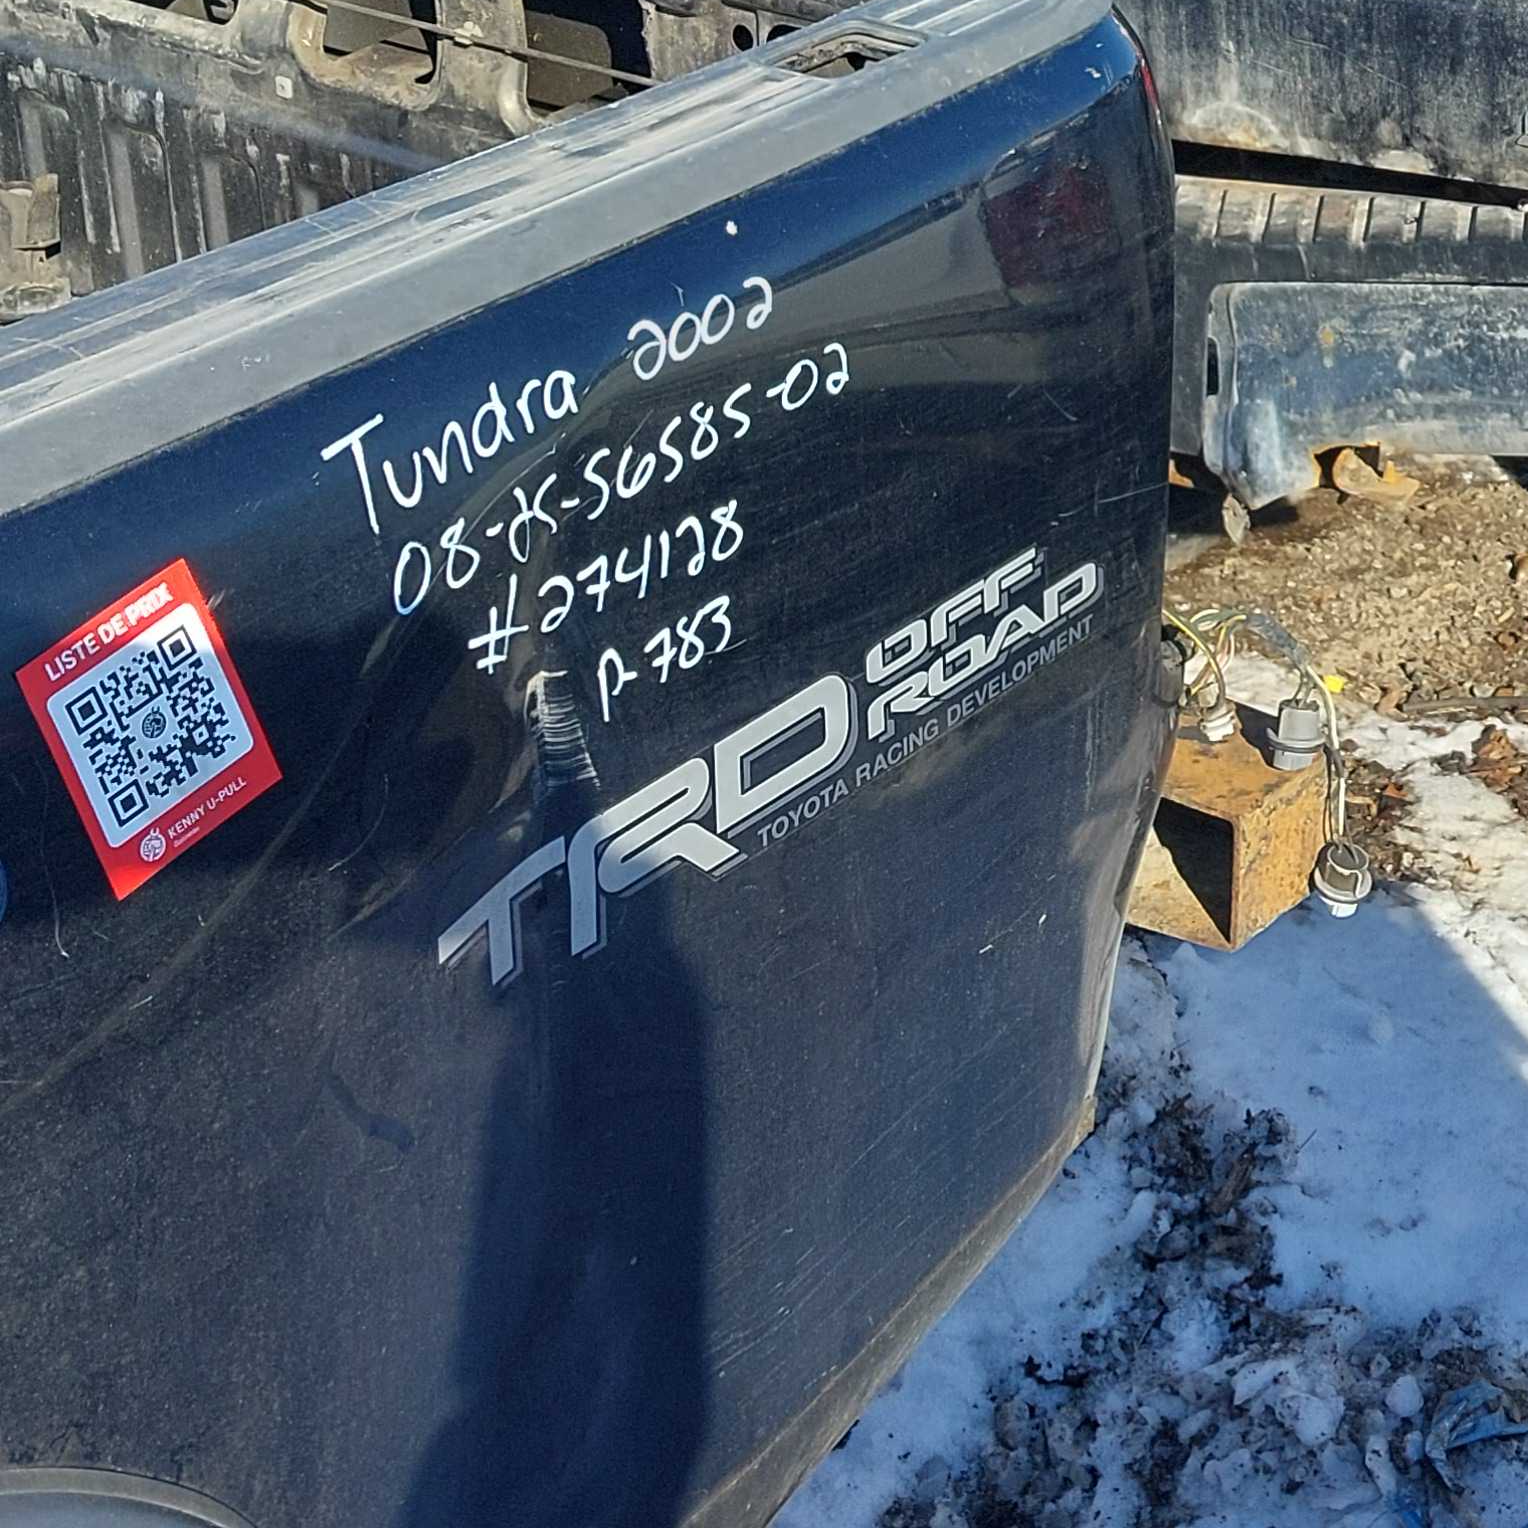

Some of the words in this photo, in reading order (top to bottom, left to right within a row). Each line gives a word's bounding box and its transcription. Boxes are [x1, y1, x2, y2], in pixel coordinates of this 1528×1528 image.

[320, 369, 578, 534] Tundra
[627, 276, 773, 381] 2002
[44, 632, 100, 681] LISTE
[97, 612, 129, 645] DE
[123, 582, 174, 626] PRIX
[468, 500, 744, 674] #274128
[866, 546, 1045, 685] OFF
[867, 562, 1104, 741] ROAD
[167, 804, 205, 839] KENNY
[206, 776, 247, 810] U-PULL
[757, 781, 849, 848] TOYOTA
[855, 718, 939, 787] RACING
[946, 614, 1093, 728] DEVELOPMENT
[437, 673, 857, 987] TRD
